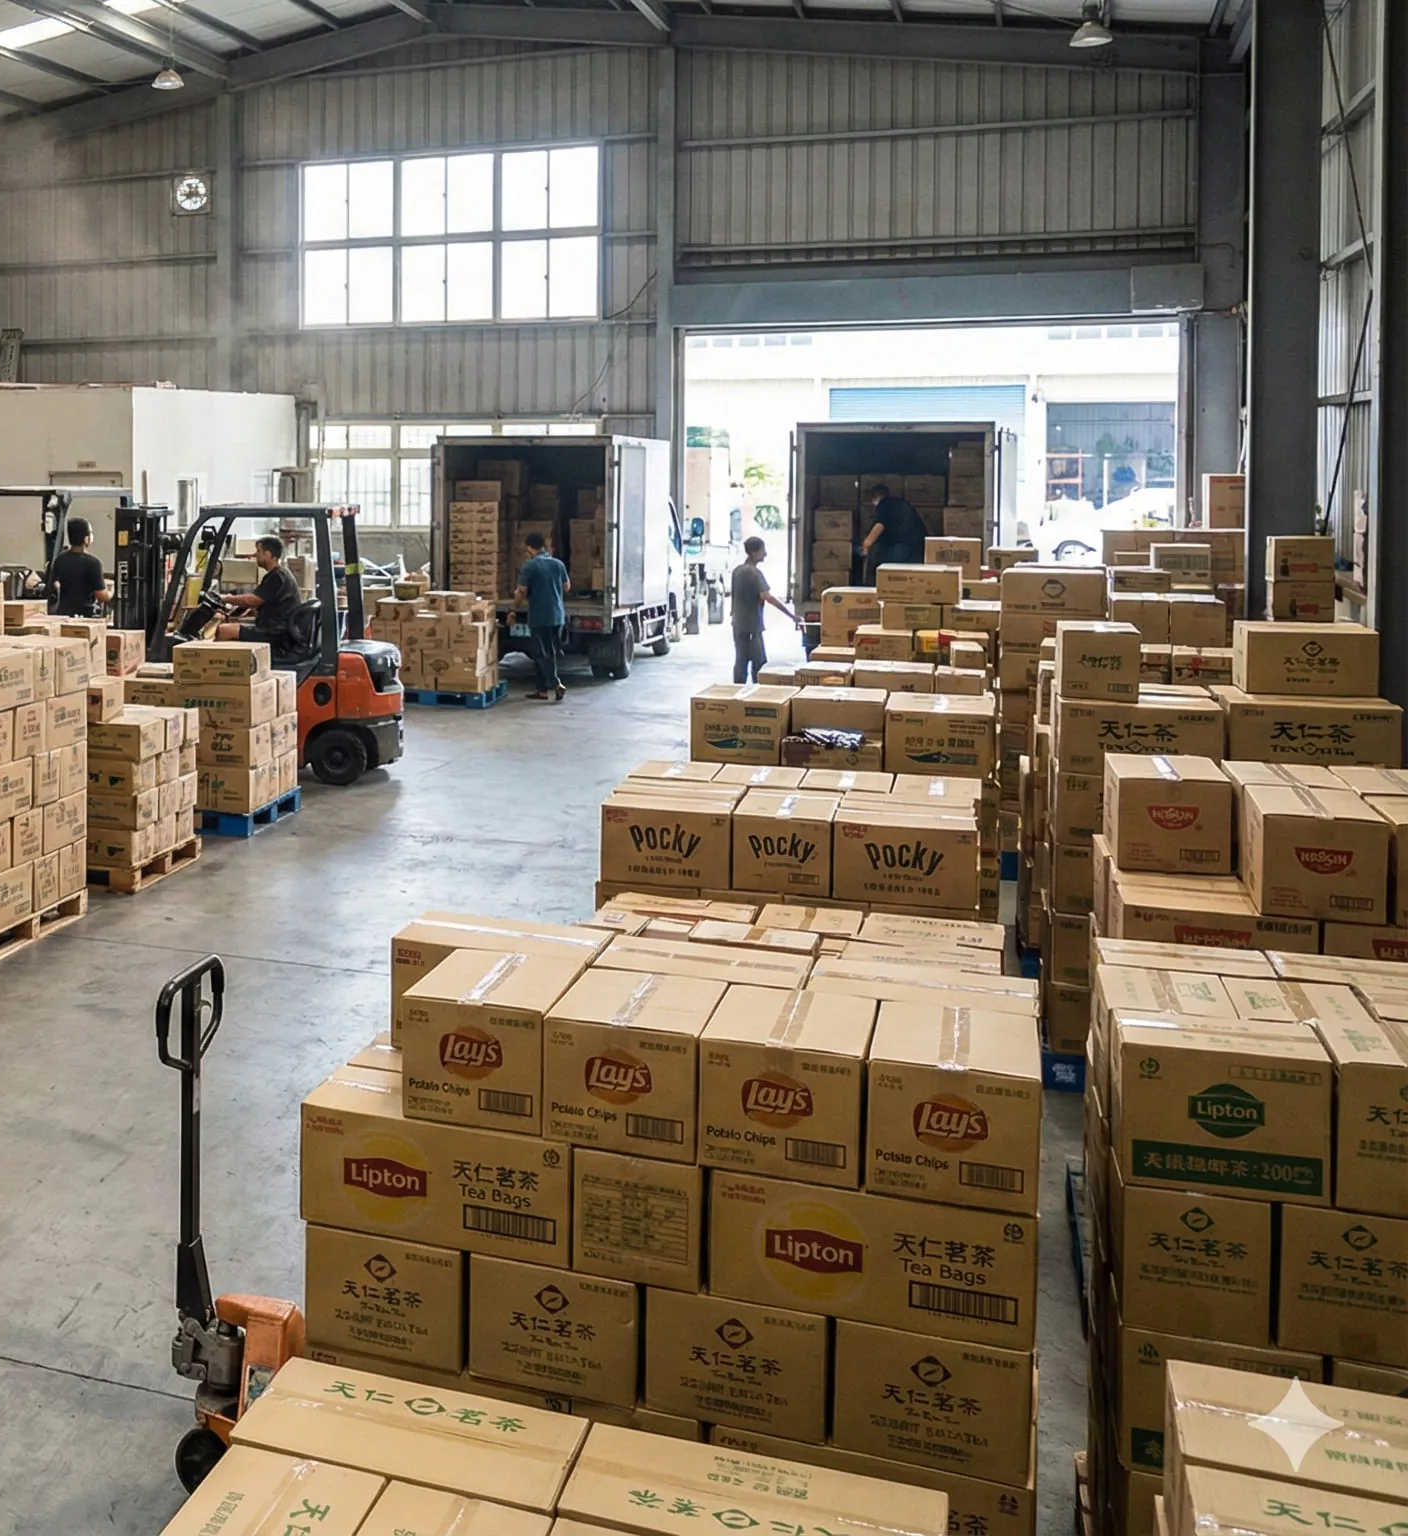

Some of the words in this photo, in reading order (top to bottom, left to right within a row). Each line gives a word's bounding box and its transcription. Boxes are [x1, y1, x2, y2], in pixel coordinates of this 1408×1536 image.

[1098, 720, 1179, 742] 天仁茶
[1270, 721, 1355, 745] 天仁茶
[628, 823, 702, 859] Pocky
[748, 832, 816, 864] Pocky
[864, 840, 944, 876] Pocky
[443, 1039, 500, 1071] Lay's
[588, 1058, 649, 1093] Lay's
[745, 1081, 812, 1114] Lay's
[1196, 1100, 1258, 1121] Lipton
[918, 1103, 987, 1138] Lay's
[351, 1161, 420, 1195] Lipton
[452, 1160, 539, 1192] 天仁茗茶
[459, 1183, 487, 1199] Tea
[492, 1188, 532, 1209] Bags
[774, 1234, 854, 1266] Lipton
[893, 1232, 997, 1269] 天仁茗茶
[1148, 1232, 1248, 1260] 天仁茗茶
[899, 1258, 932, 1276] Tea
[939, 1266, 987, 1287] Bags
[341, 1279, 423, 1310] 天仁茗茶
[510, 1311, 597, 1341] 天仁茗茶
[688, 1346, 783, 1377] 天仁茗茶
[881, 1383, 983, 1417] 天仁茗茶
